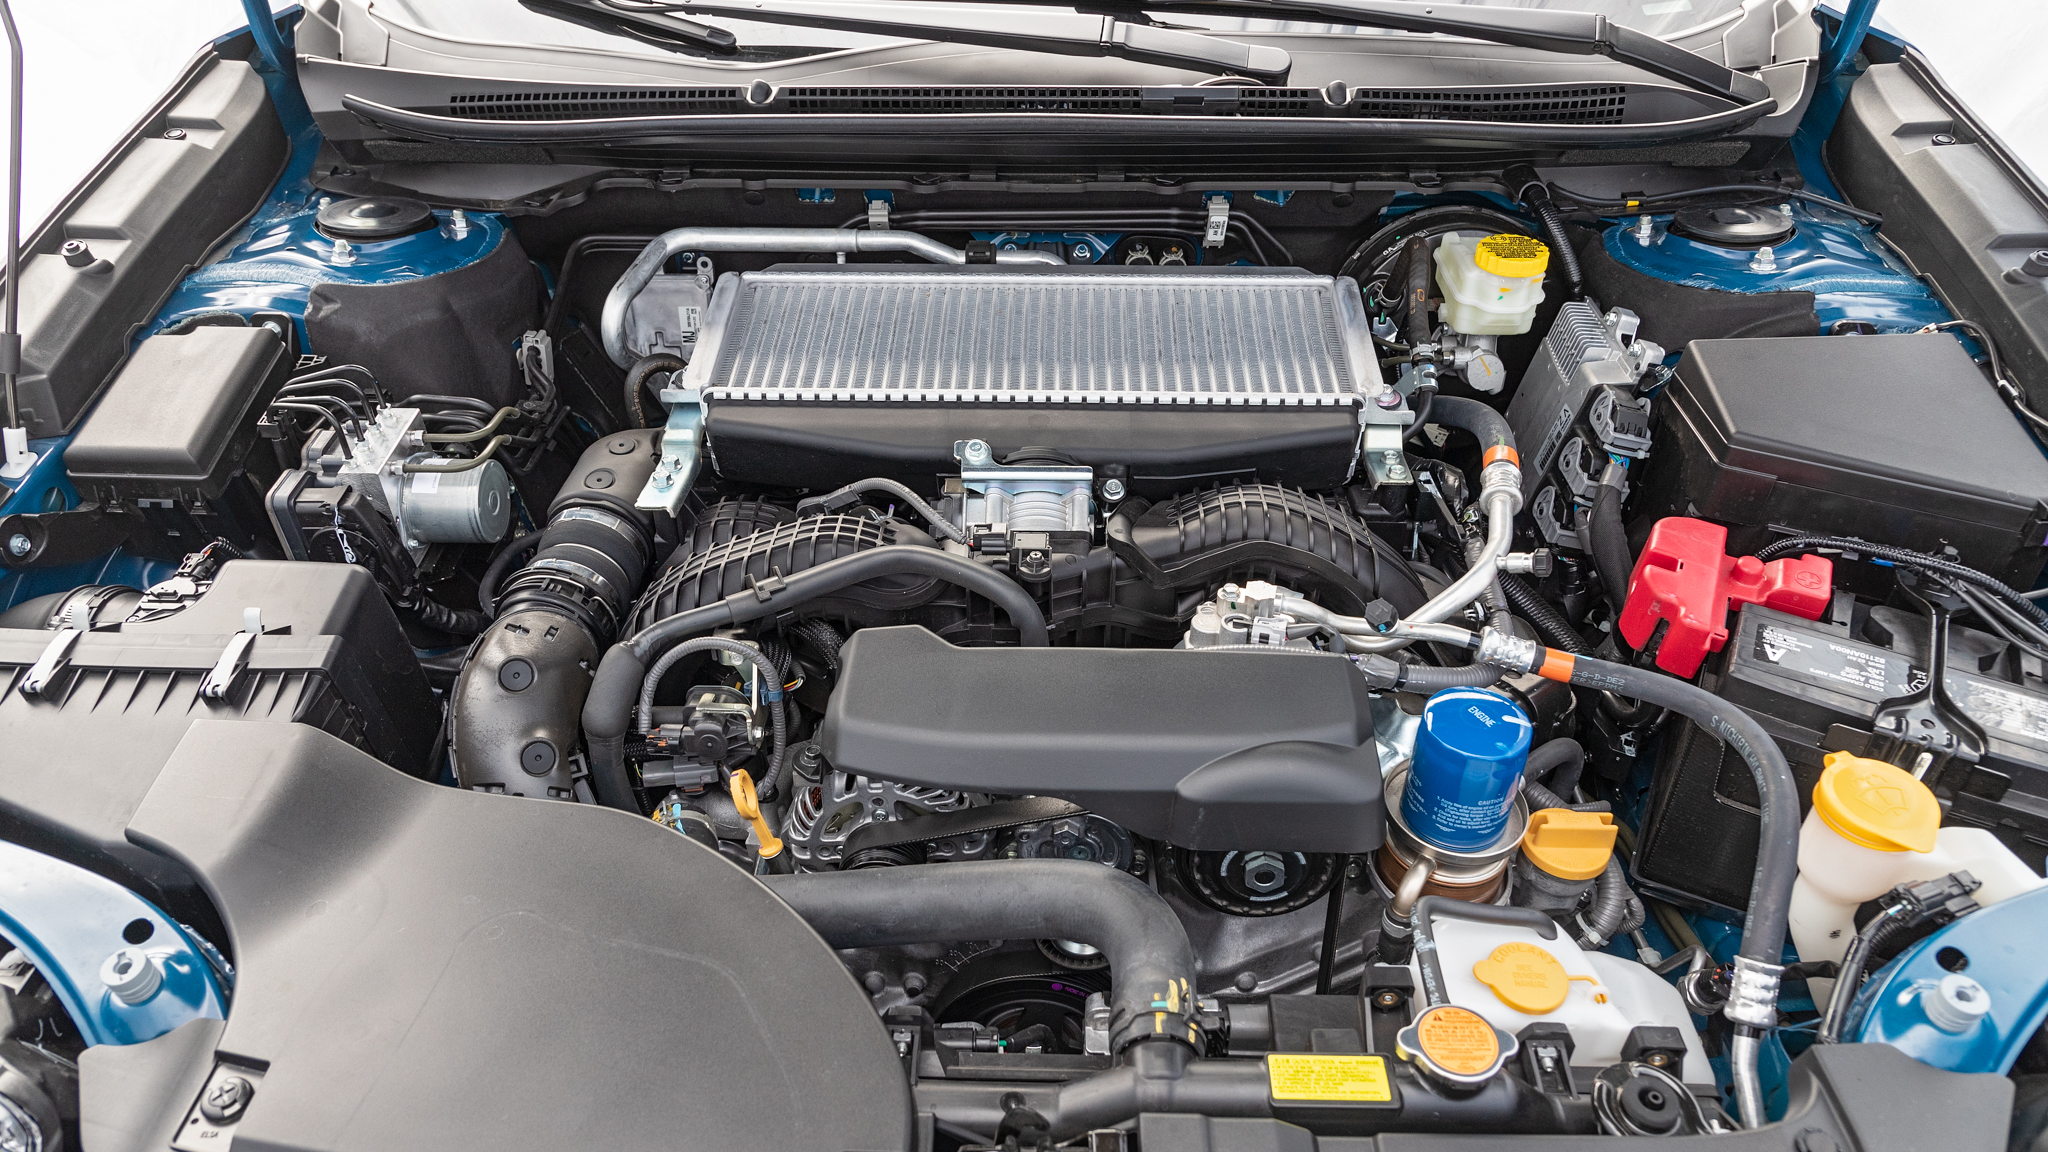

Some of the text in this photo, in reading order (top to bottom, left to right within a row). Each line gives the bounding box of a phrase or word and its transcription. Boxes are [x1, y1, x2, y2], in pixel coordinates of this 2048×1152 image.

[682, 331, 695, 343] MJ
[1840, 670, 1885, 687] 620 AMPS
[1865, 683, 1885, 692] COLD
[1467, 705, 1496, 728] ENGINE
[1478, 797, 1504, 805] CAUTION
[1493, 945, 1557, 964] COOLANT
